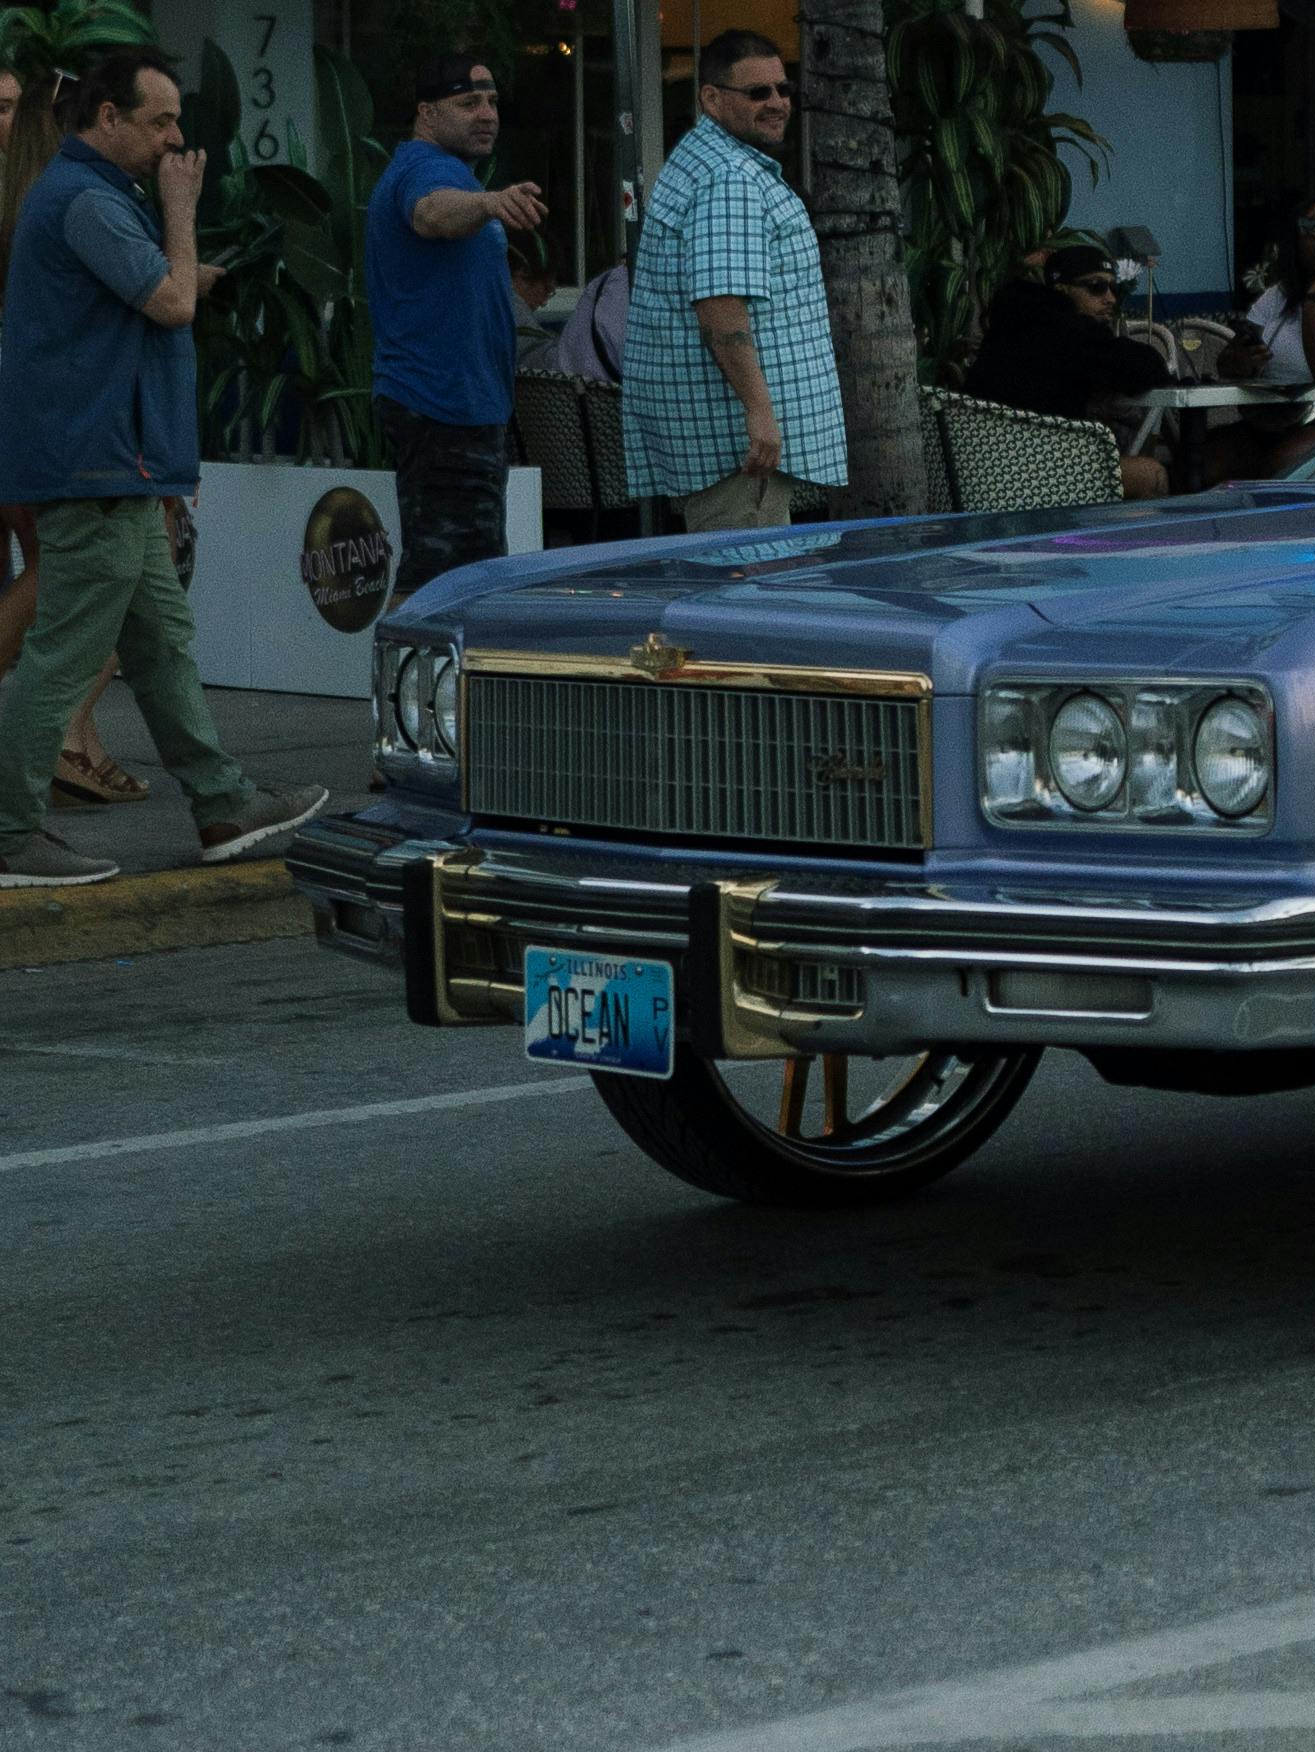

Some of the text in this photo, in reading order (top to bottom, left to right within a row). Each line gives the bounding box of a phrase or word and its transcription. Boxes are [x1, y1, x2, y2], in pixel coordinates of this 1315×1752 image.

[252, 15, 279, 161] 736
[566, 959, 627, 981] ILLINOIS
[547, 984, 629, 1050] OCEAN
